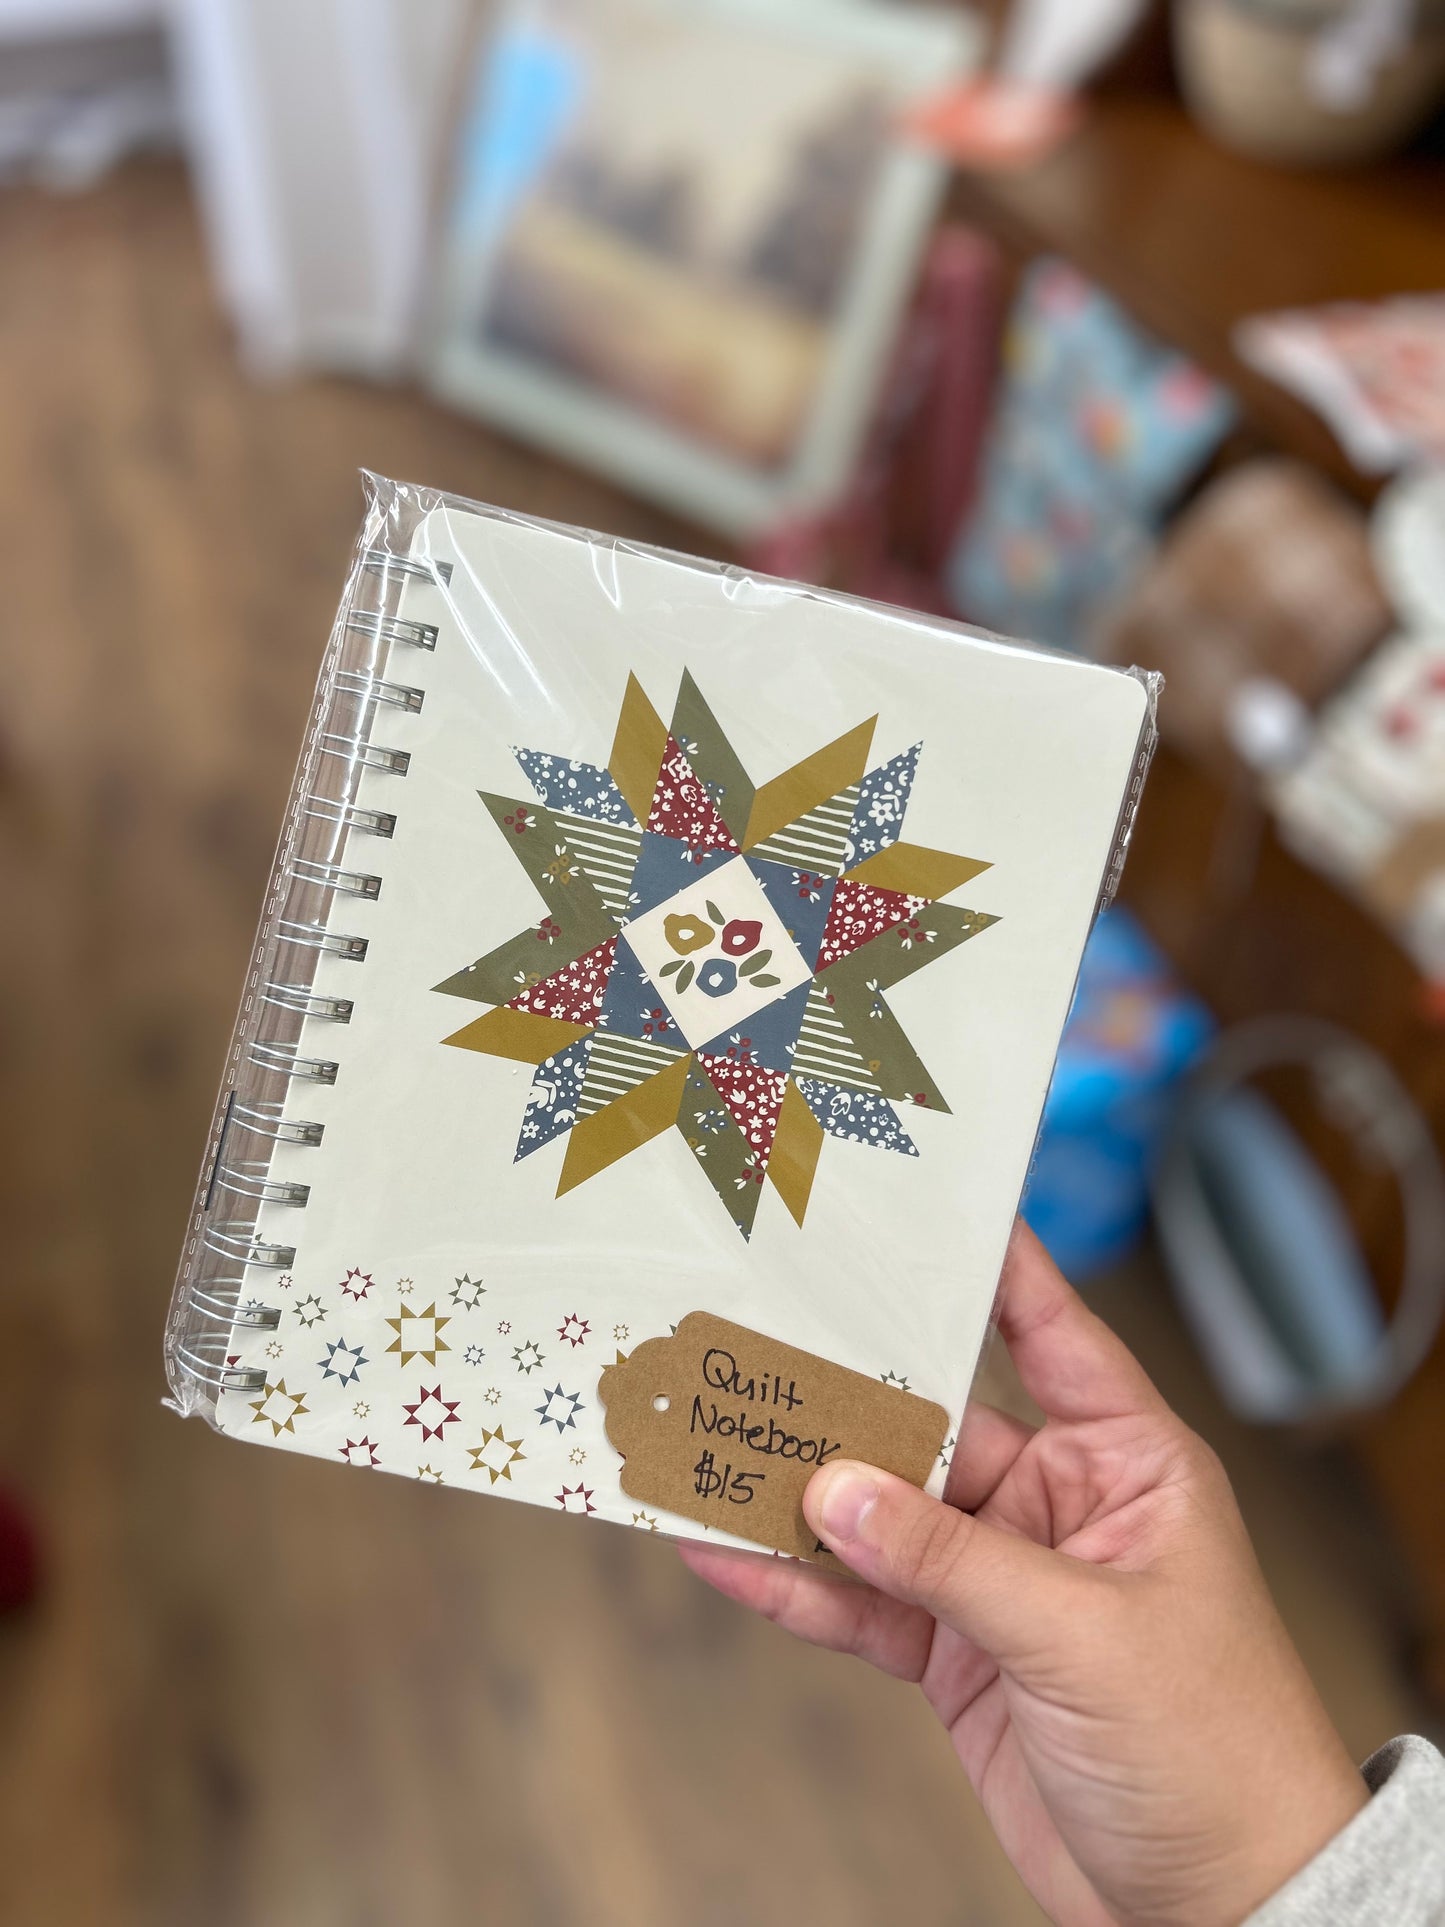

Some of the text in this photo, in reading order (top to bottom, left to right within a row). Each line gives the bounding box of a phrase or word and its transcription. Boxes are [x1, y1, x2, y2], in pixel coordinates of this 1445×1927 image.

[703, 1348, 803, 1411] Quilt
[690, 1394, 841, 1466] Notebook
[694, 1450, 765, 1504] $15
